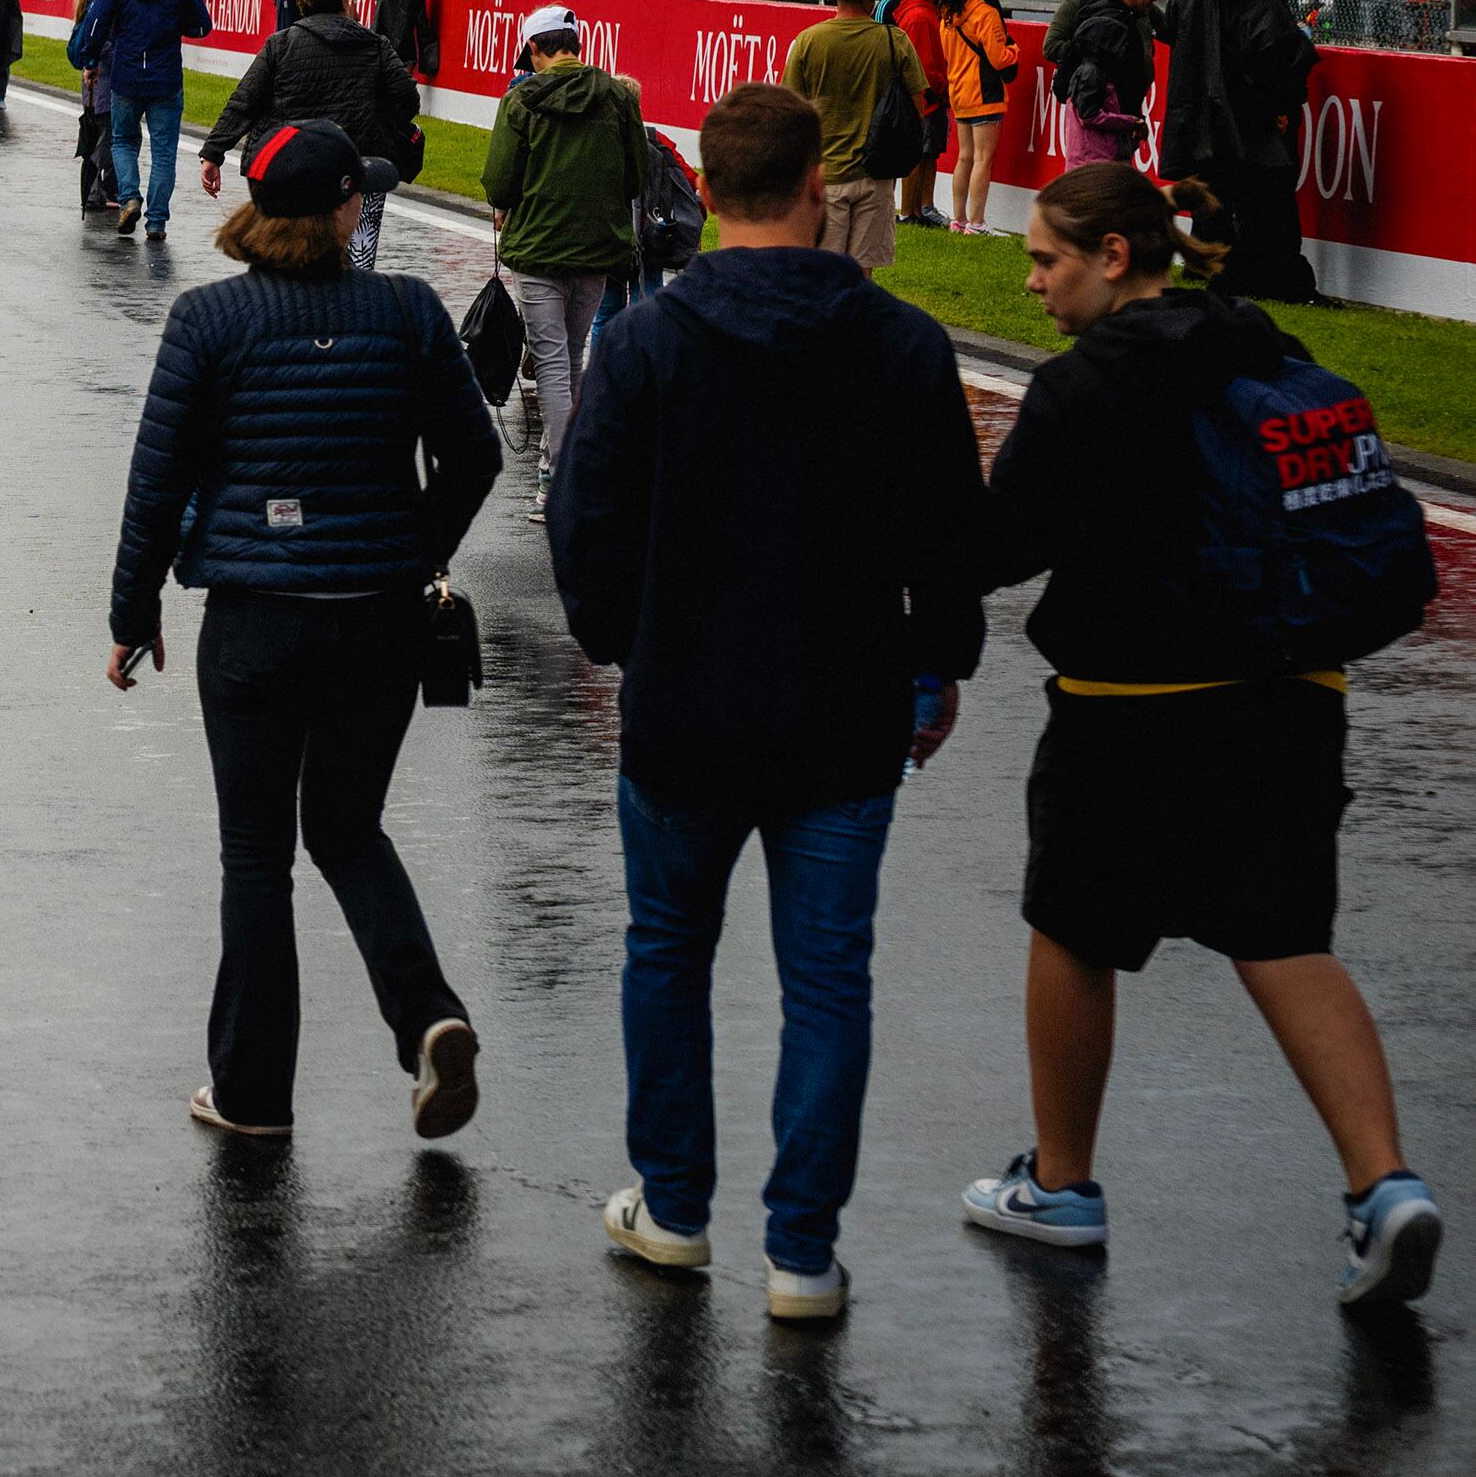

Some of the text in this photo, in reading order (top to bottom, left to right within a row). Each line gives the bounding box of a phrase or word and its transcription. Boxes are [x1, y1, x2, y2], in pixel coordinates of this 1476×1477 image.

[690, 14, 761, 104] MOËT
[763, 35, 779, 84] &
[1258, 397, 1378, 454] SUPER
